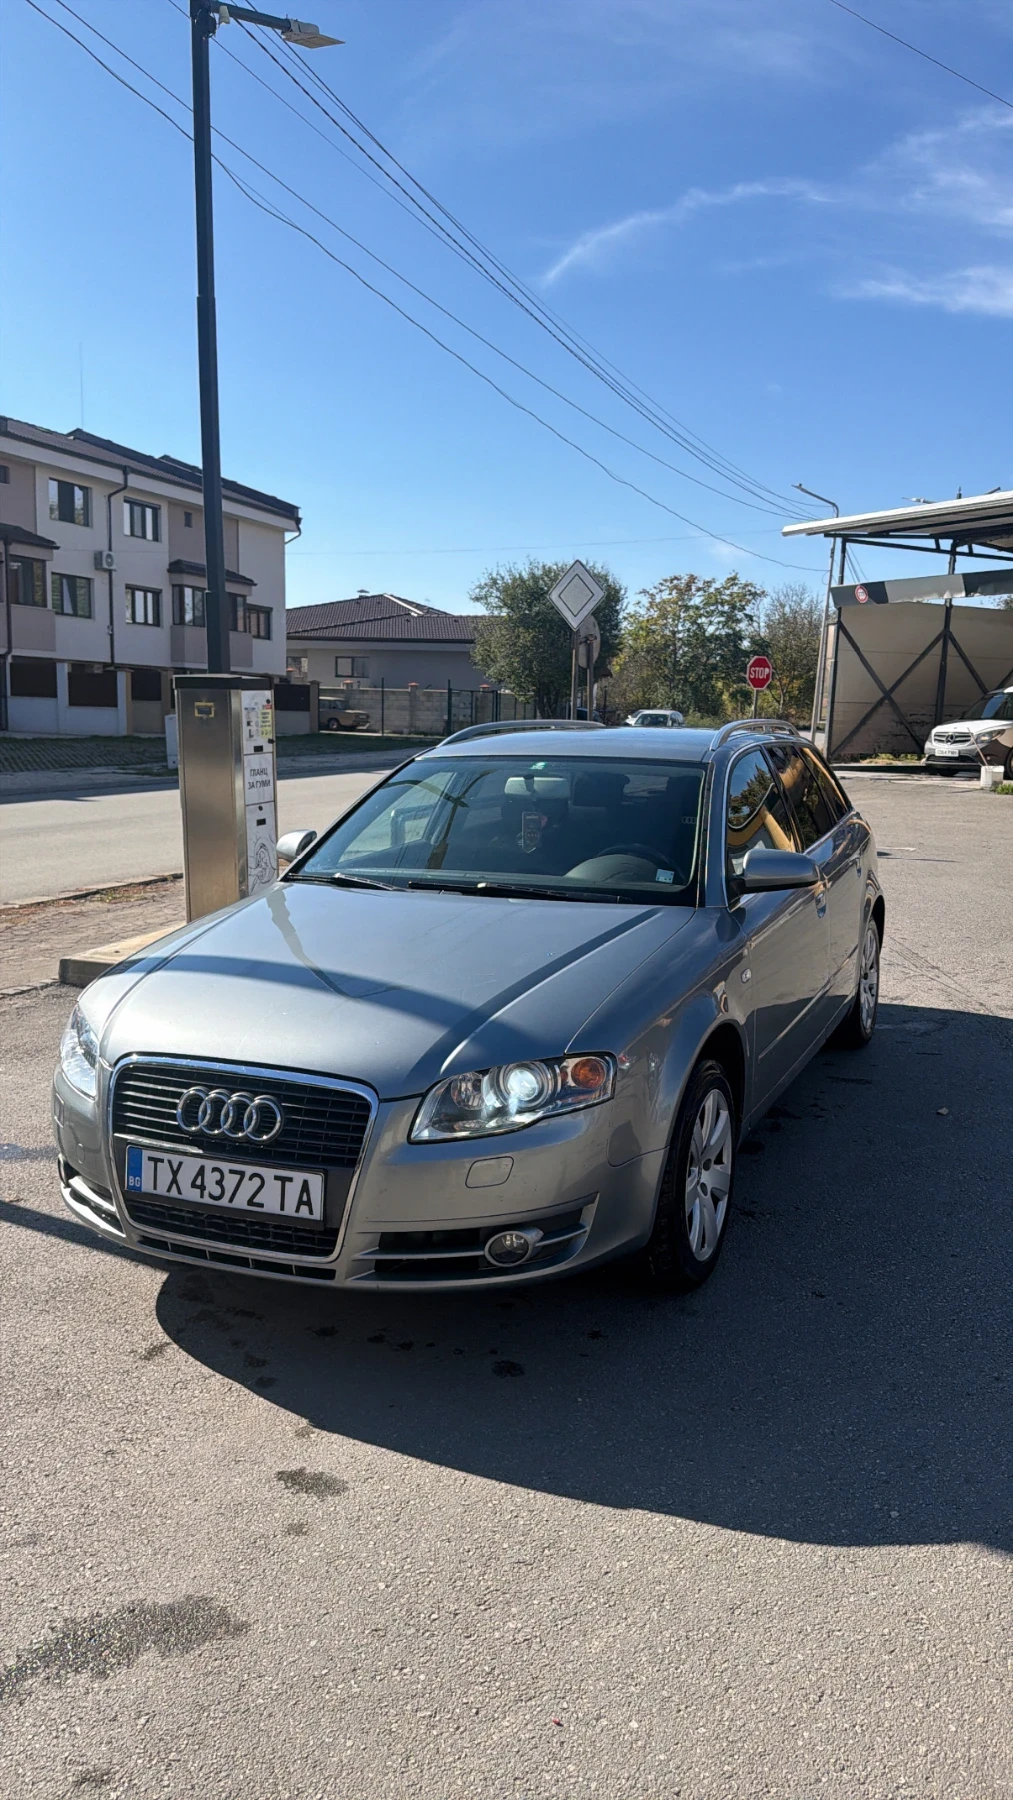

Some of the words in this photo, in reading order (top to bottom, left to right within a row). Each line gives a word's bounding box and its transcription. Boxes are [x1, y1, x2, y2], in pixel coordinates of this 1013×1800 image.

[750, 667, 770, 679] STOP
[250, 767, 268, 777] ГЛАНЦ
[247, 781, 255, 790] ЗА
[256, 779, 271, 789] ГУМИ
[128, 1176, 141, 1188] BG
[147, 1156, 184, 1196] TX
[190, 1164, 266, 1209] 4372
[273, 1174, 314, 1216] TA
